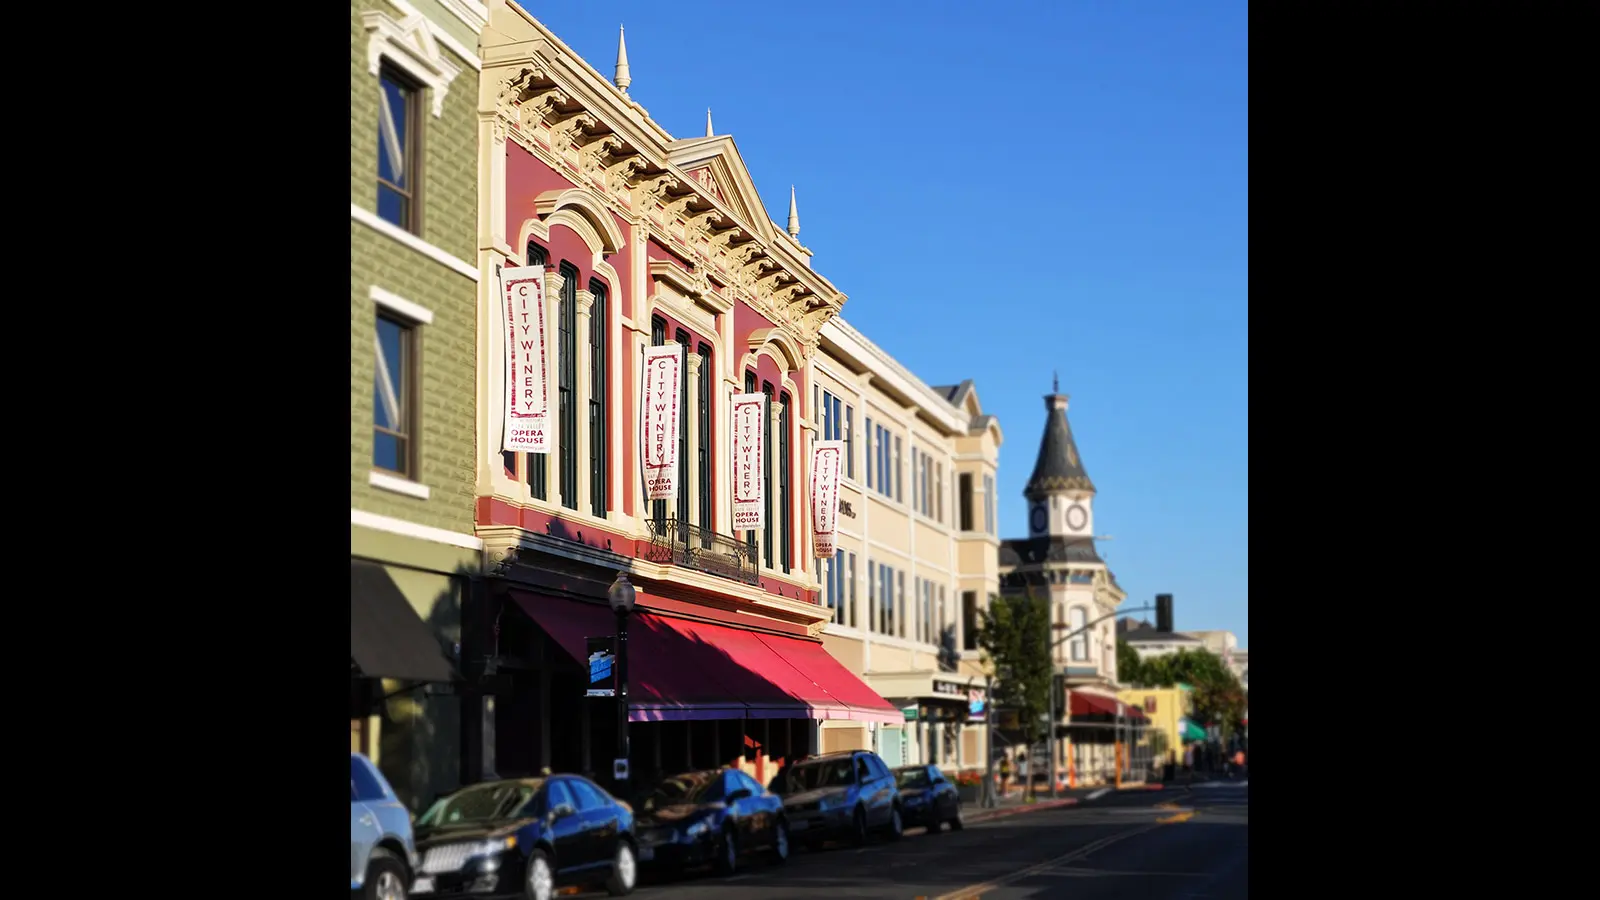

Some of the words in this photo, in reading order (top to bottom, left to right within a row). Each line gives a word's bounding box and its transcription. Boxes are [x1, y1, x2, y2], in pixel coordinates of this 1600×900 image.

[519, 286, 530, 335] CITY
[521, 340, 533, 410] WINERY
[657, 361, 666, 399] CITY
[511, 429, 544, 437] OPERA
[655, 404, 666, 461] WINERY
[648, 478, 671, 486] OPERA
[742, 446, 752, 497] WINERY
